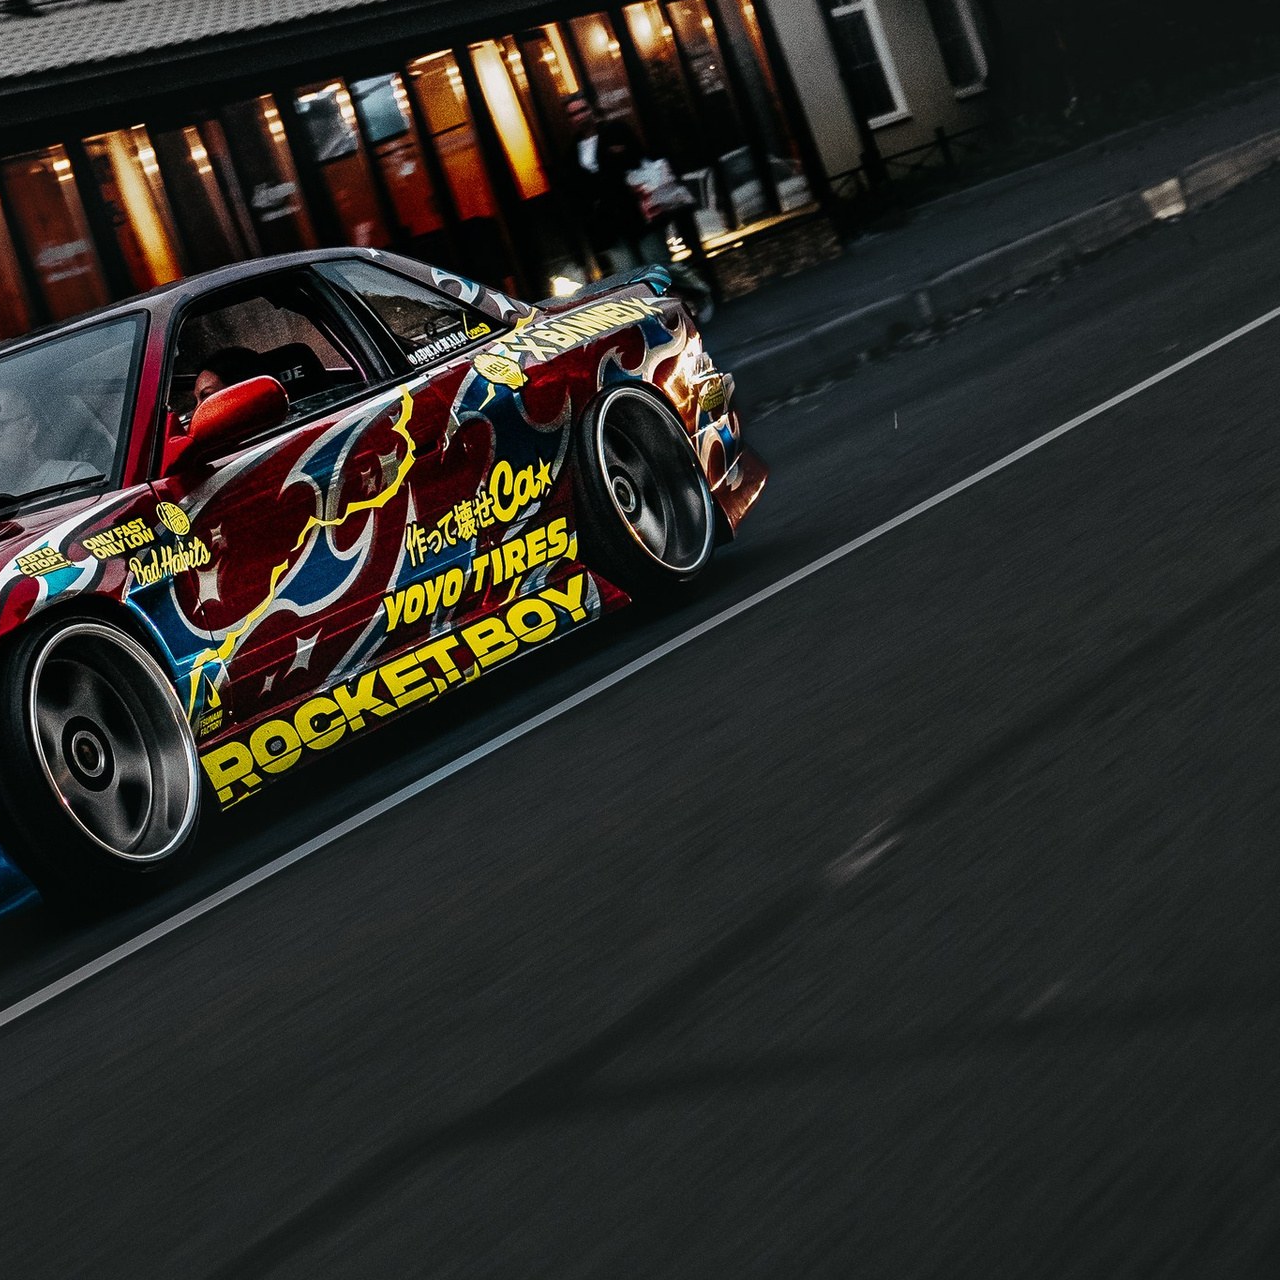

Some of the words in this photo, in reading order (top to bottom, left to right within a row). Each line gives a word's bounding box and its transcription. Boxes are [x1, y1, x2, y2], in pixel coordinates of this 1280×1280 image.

[483, 360, 509, 376] HELL
[82, 528, 116, 550] ONLY
[113, 517, 147, 539] FAST
[92, 539, 126, 560] ONLY
[124, 528, 155, 548] LOW
[406, 491, 495, 567] 作って壊せ
[18, 547, 56, 567] АВТО
[129, 548, 163, 587] Bad
[161, 536, 211, 577] Habits
[383, 568, 463, 632] YOYO
[473, 517, 568, 592] TIRES
